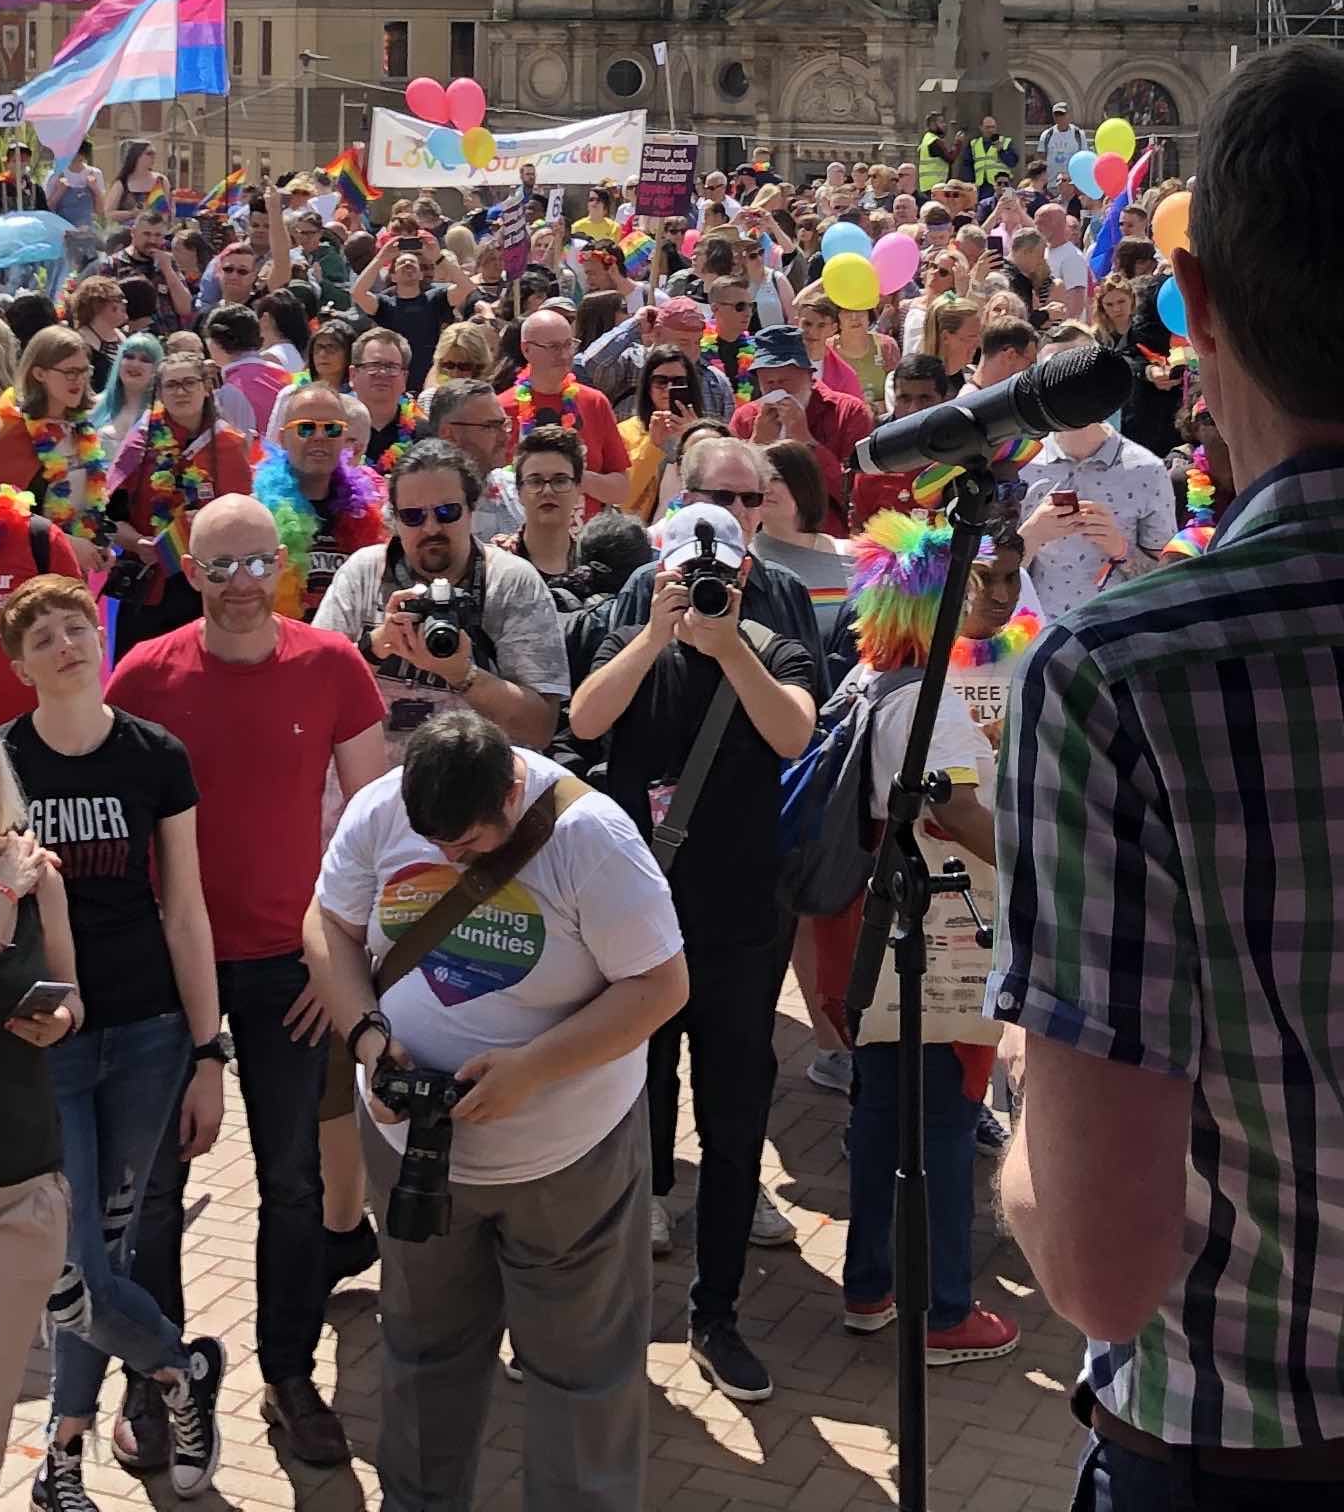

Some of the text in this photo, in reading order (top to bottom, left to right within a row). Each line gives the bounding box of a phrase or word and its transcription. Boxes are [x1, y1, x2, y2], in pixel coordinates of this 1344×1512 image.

[537, 143, 631, 167] nature
[952, 686, 1001, 701] FREE
[29, 797, 129, 845] GENDER
